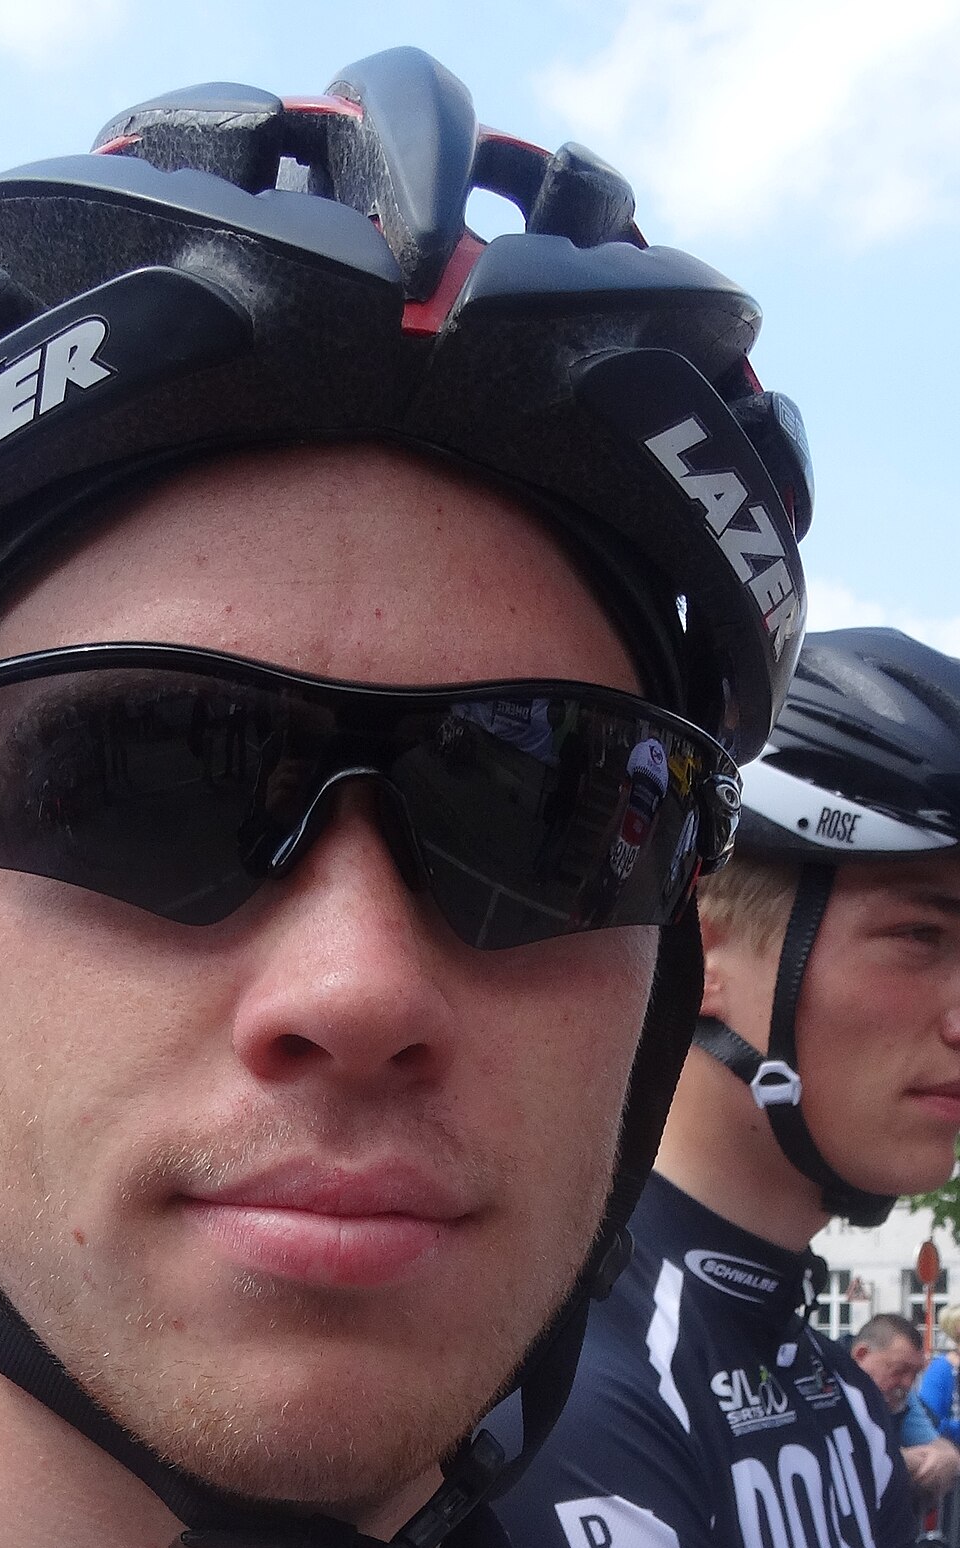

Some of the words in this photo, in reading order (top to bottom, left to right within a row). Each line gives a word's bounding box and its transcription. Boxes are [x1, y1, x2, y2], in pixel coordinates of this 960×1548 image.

[643, 416, 800, 663] LAZER
[816, 807, 861, 843] ROSE
[702, 1259, 780, 1293] SCHWALBE
